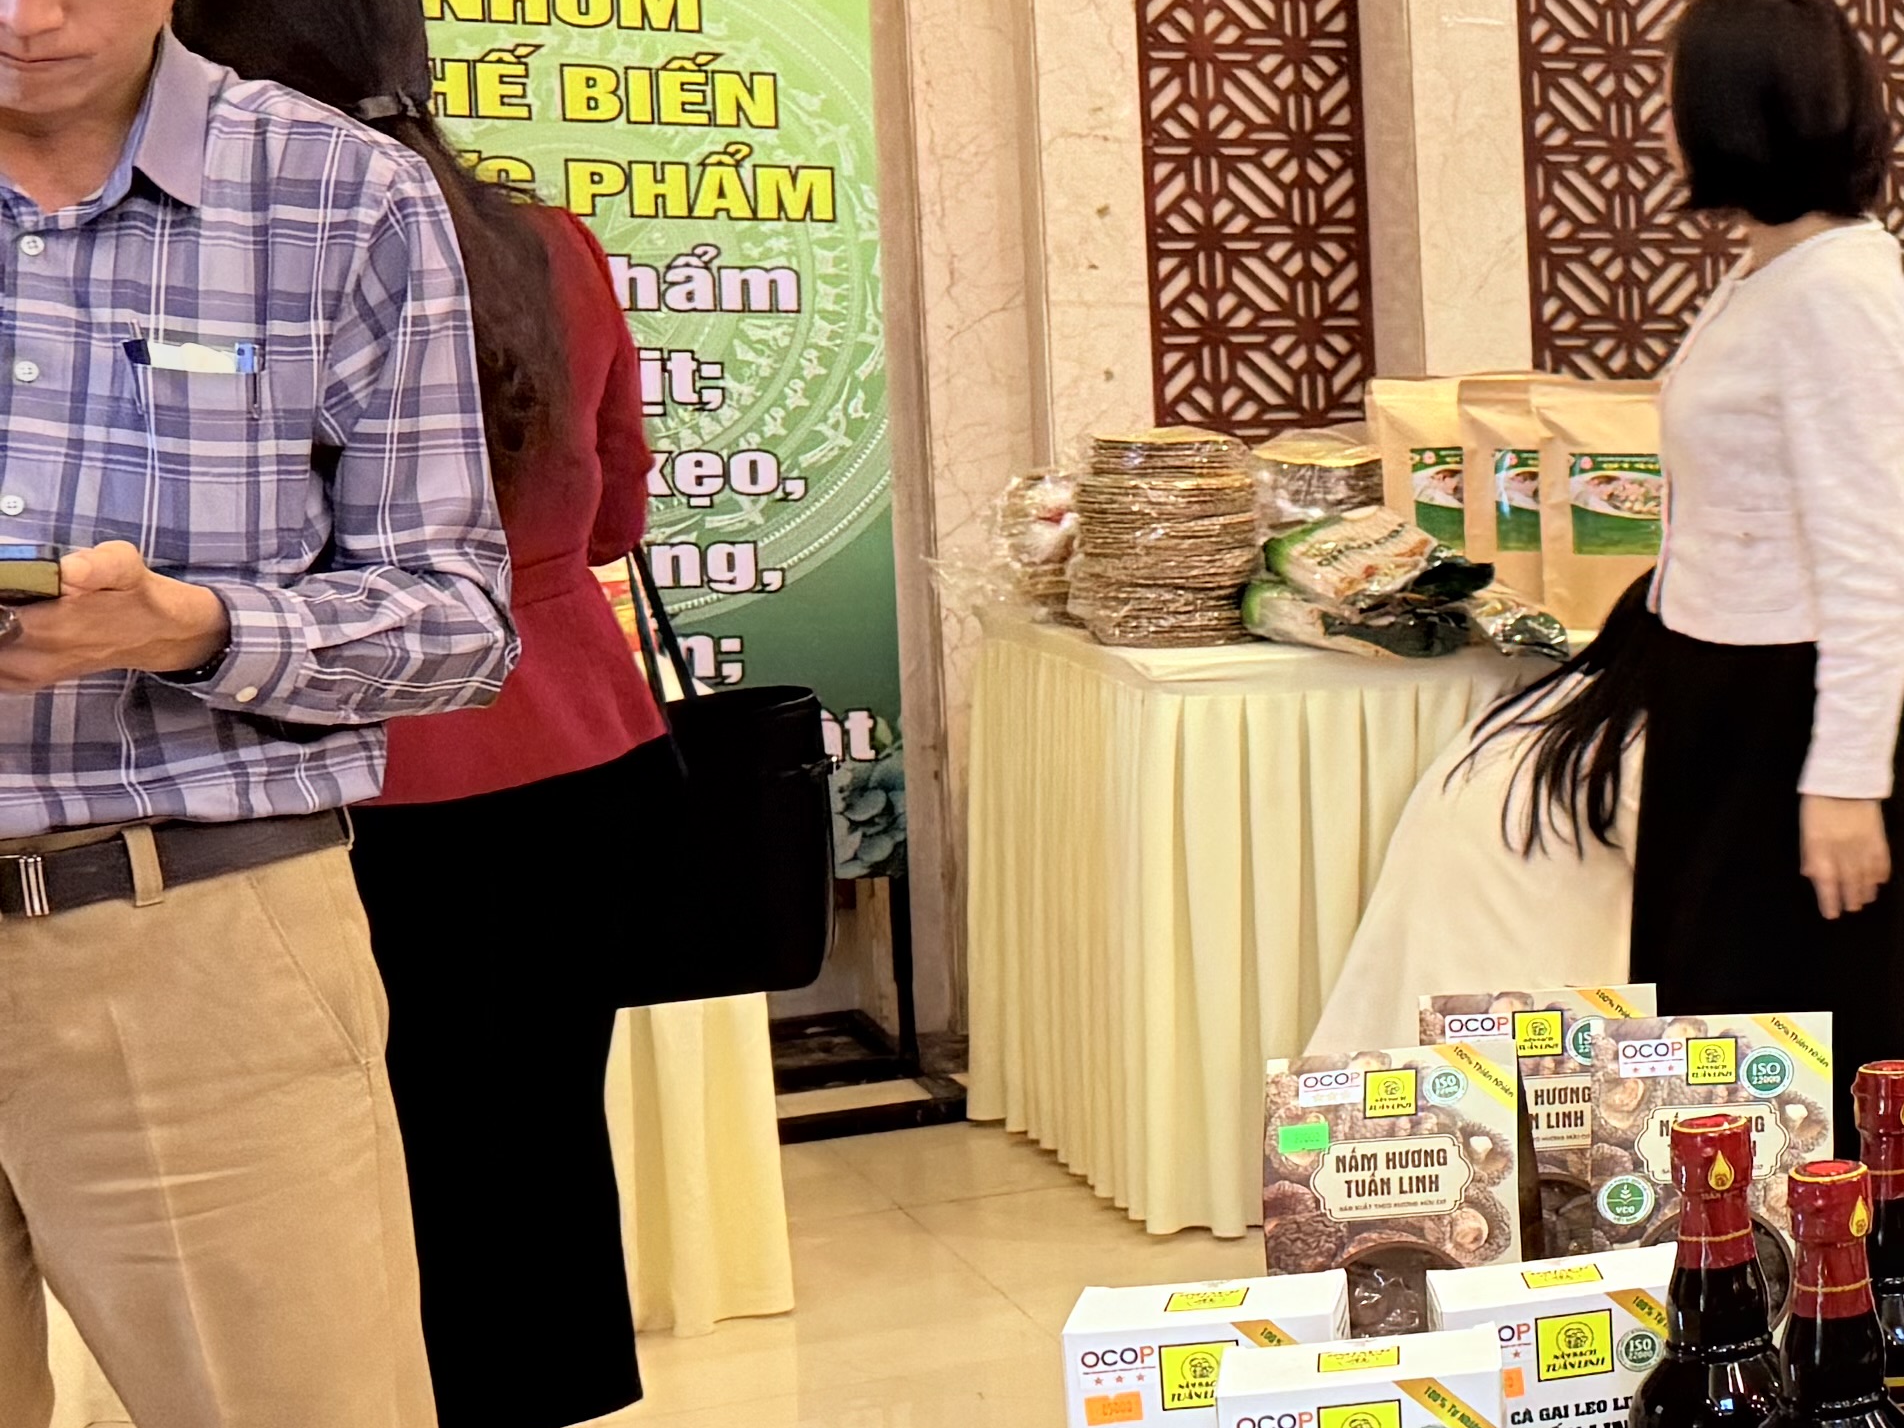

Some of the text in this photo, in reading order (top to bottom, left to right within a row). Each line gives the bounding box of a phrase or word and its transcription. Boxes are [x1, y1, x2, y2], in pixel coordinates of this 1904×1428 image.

[428, 44, 778, 129] HẾ BIẾN
[564, 144, 836, 222] PHẨM
[1449, 1015, 1509, 1033] OCOP
[1622, 1042, 1684, 1059] OCOP
[1303, 1072, 1360, 1089] OCOP
[1546, 1112, 1584, 1128] LINH
[1335, 1147, 1448, 1172] NẤM HƯƠNG
[1399, 1174, 1440, 1195] LINH
[1081, 1345, 1155, 1369] OCOP
[1511, 1399, 1607, 1425] CÀ GAI LEO
